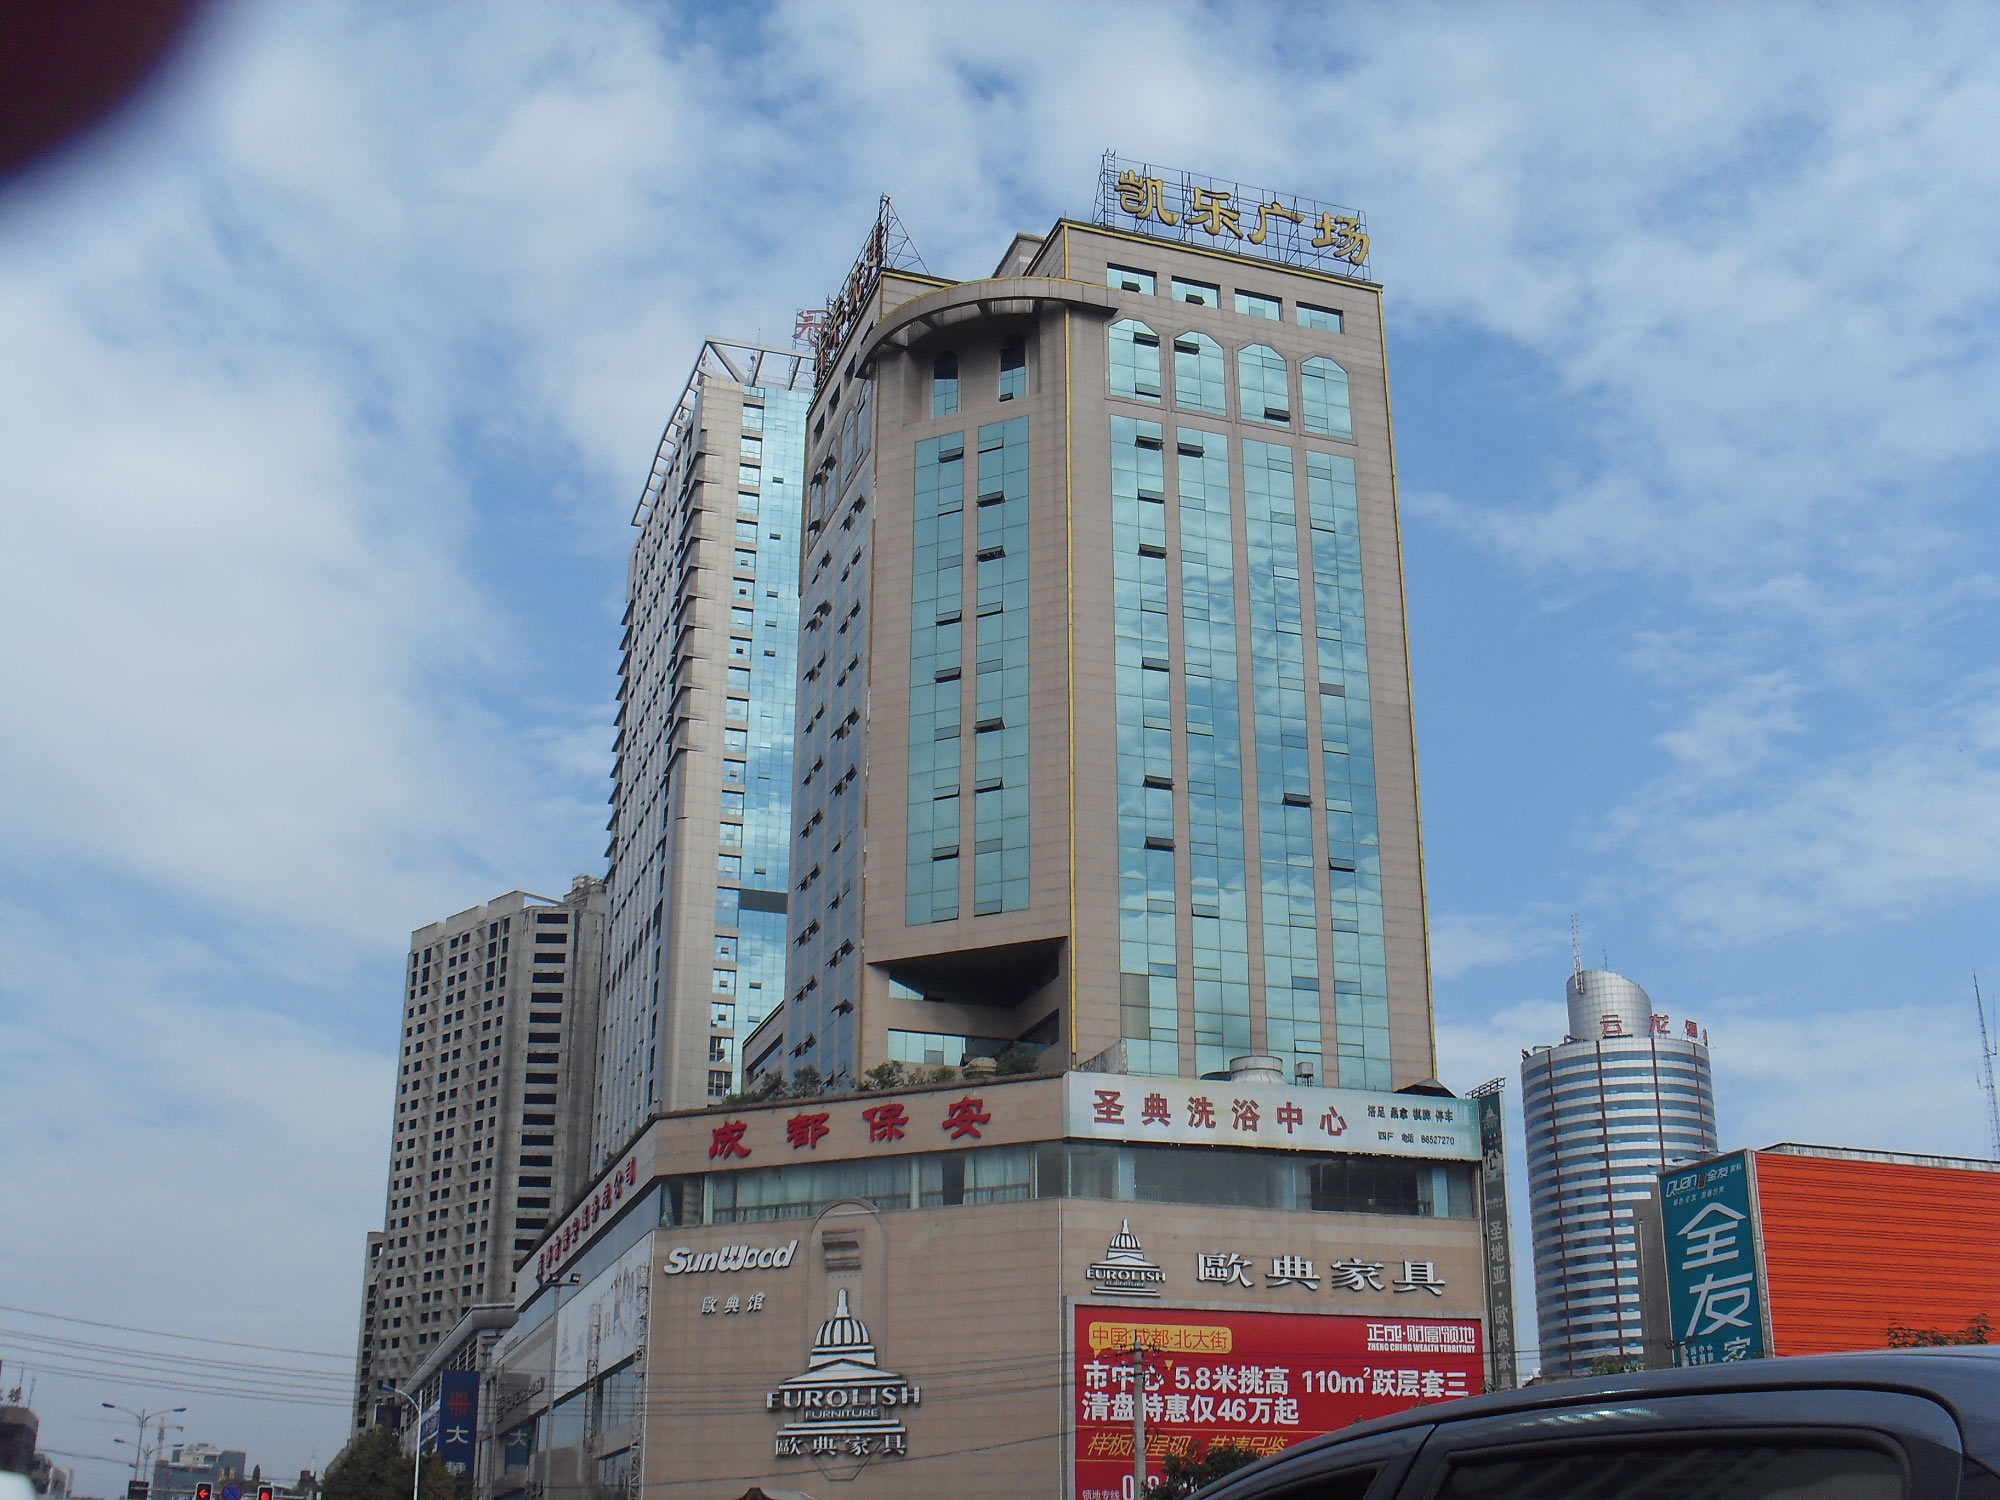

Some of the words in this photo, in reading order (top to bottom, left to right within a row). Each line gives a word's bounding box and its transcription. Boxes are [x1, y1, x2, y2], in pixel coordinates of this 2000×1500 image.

[1114, 169, 1371, 266] 凯乐广场
[709, 1096, 992, 1159] 成都保安
[1093, 1089, 1348, 1137] 圣典洗浴中心
[663, 1239, 800, 1276] SunWood
[1086, 1269, 1166, 1283] EUROLISH
[1367, 1342, 1389, 1352] ZHENG
[1413, 1344, 1439, 1353] WEALTH
[1174, 1364, 1290, 1395] 5.8米挑高
[804, 1408, 879, 1419] FURNITURE
